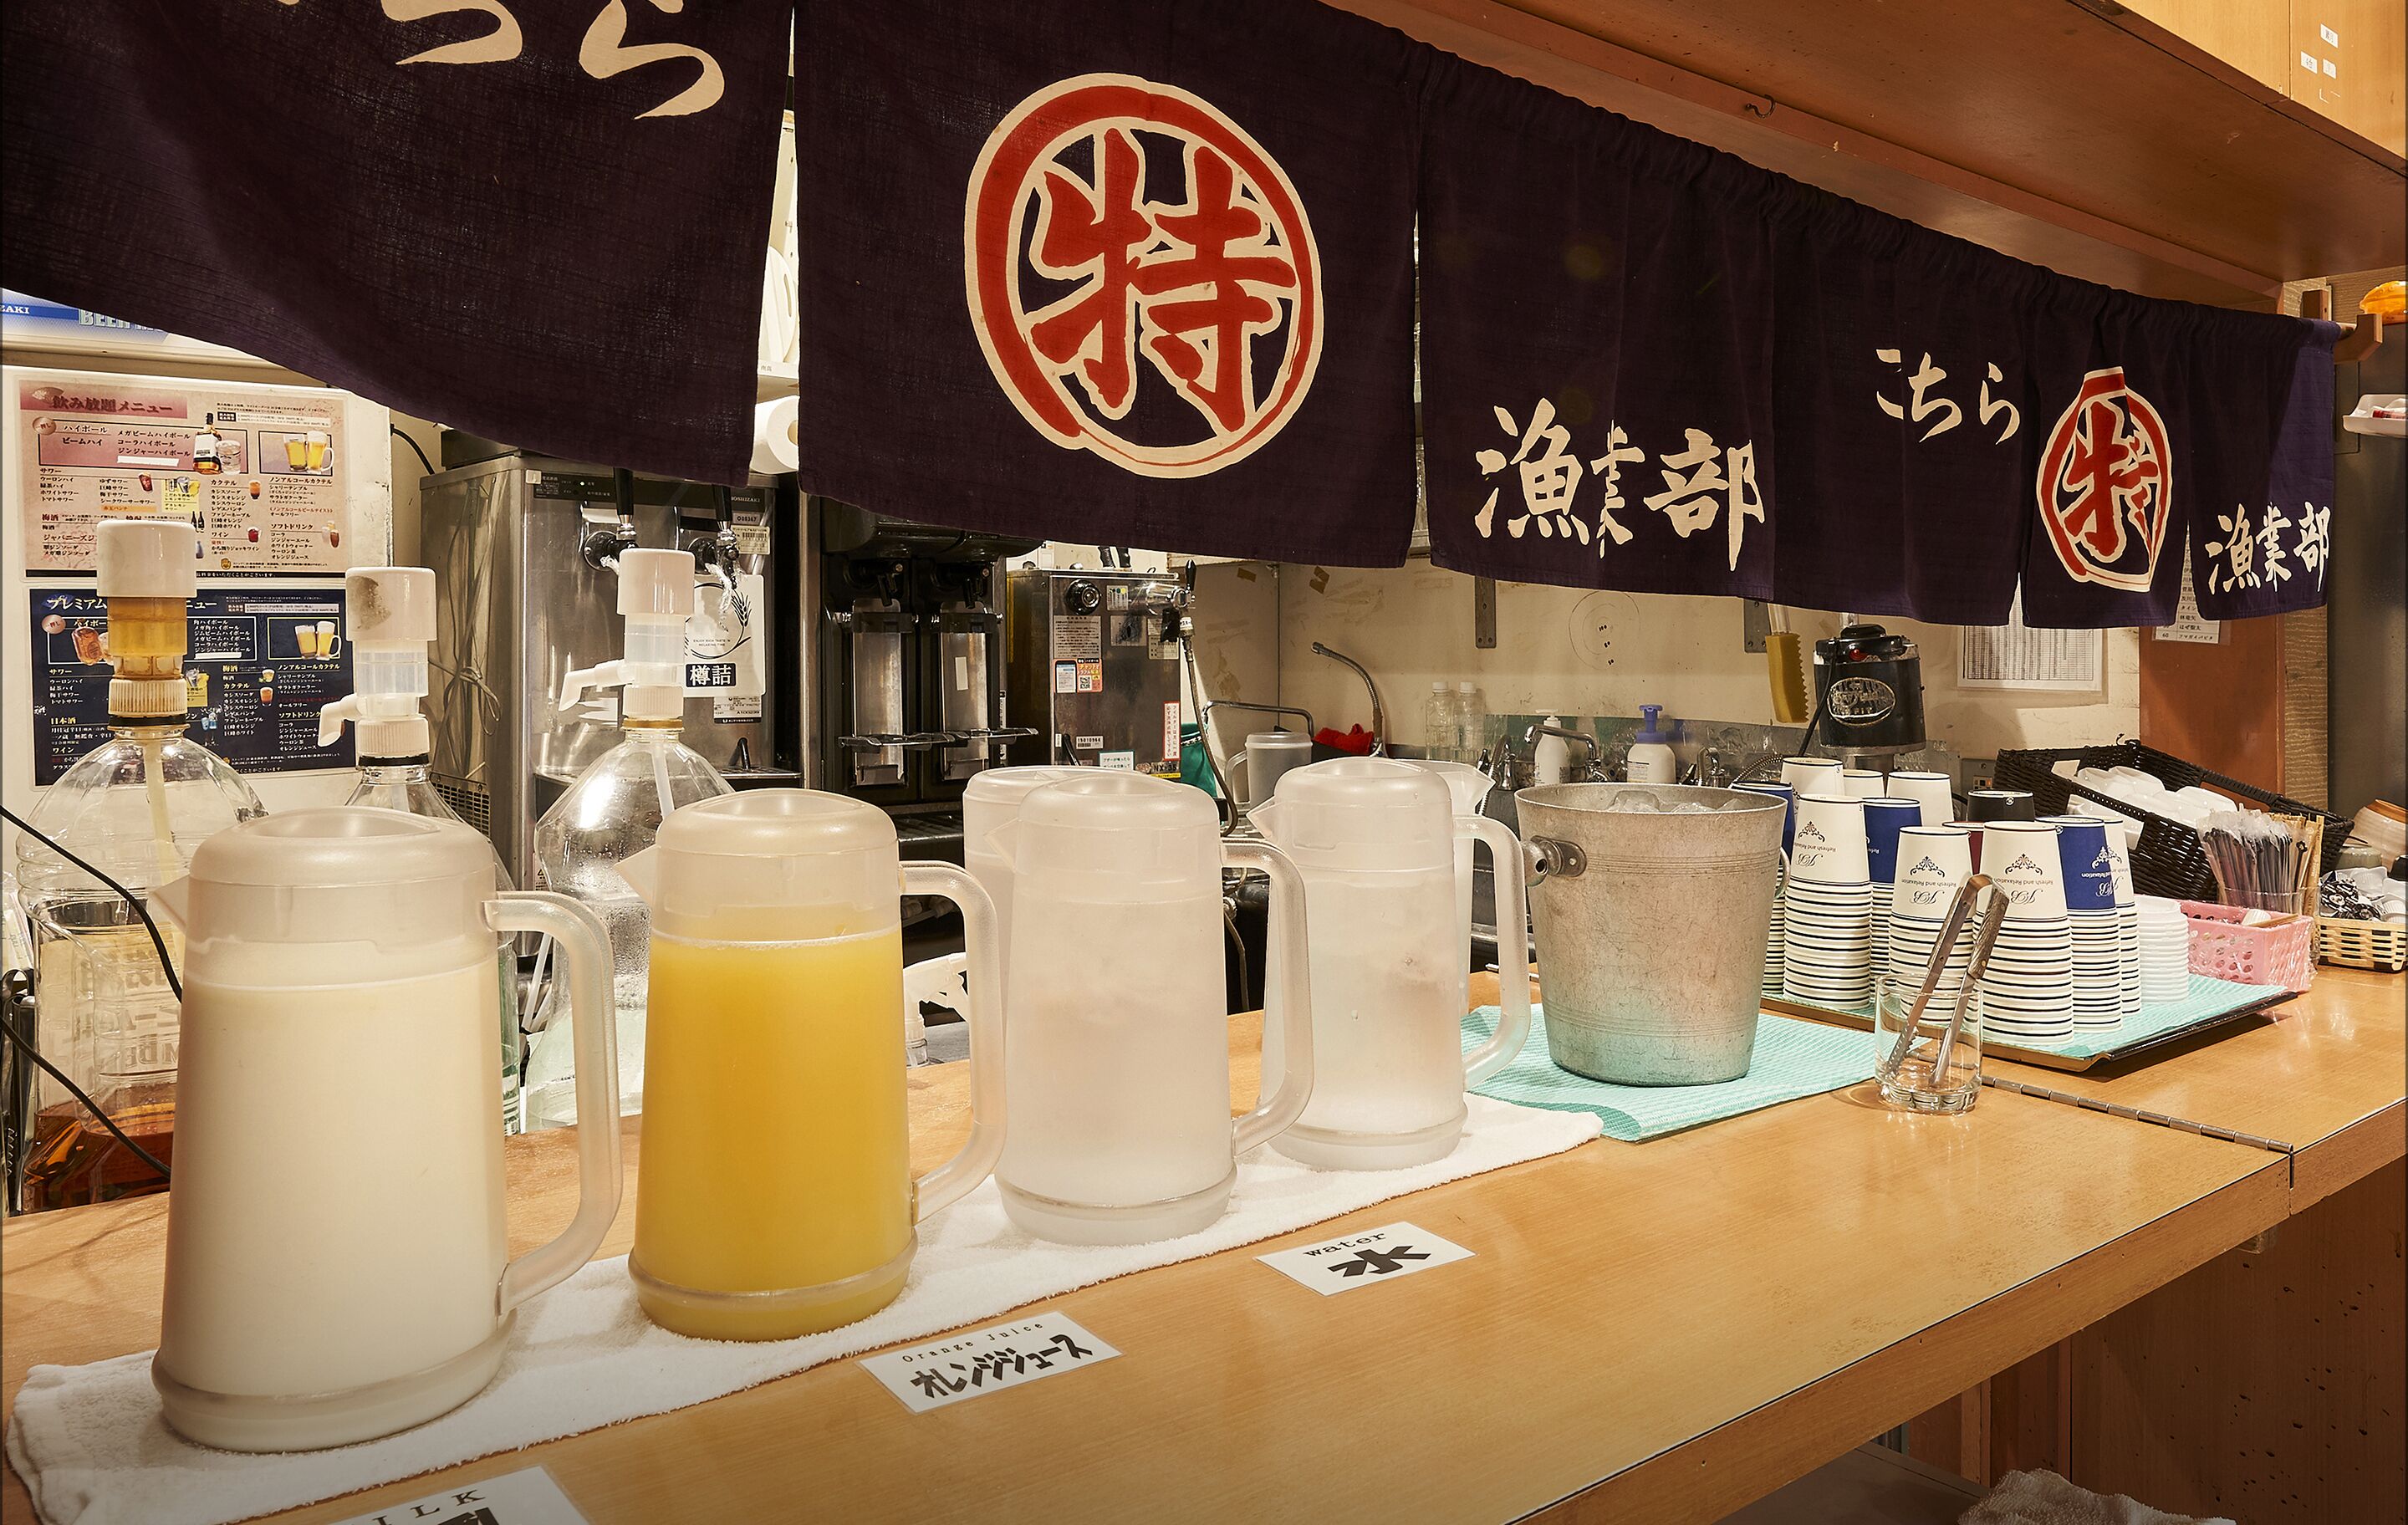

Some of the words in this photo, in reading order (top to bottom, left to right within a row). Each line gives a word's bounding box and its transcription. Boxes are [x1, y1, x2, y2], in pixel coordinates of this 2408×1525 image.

[1022, 120, 1301, 443] 特
[51, 395, 173, 415] 飲み放題メニュー
[1876, 349, 2020, 444] こちら
[1475, 398, 1765, 571] 漁業部
[2205, 502, 2331, 594] 漁業部
[47, 596, 107, 610] プレミアム
[689, 665, 732, 686] 樽詰
[1303, 1230, 1388, 1260] water
[1327, 1244, 1432, 1278] 水
[901, 1341, 975, 1364] Orange
[986, 1323, 1044, 1342] Juice
[909, 1334, 1094, 1399] オレンジジュース
[372, 1489, 486, 1525] ILK
